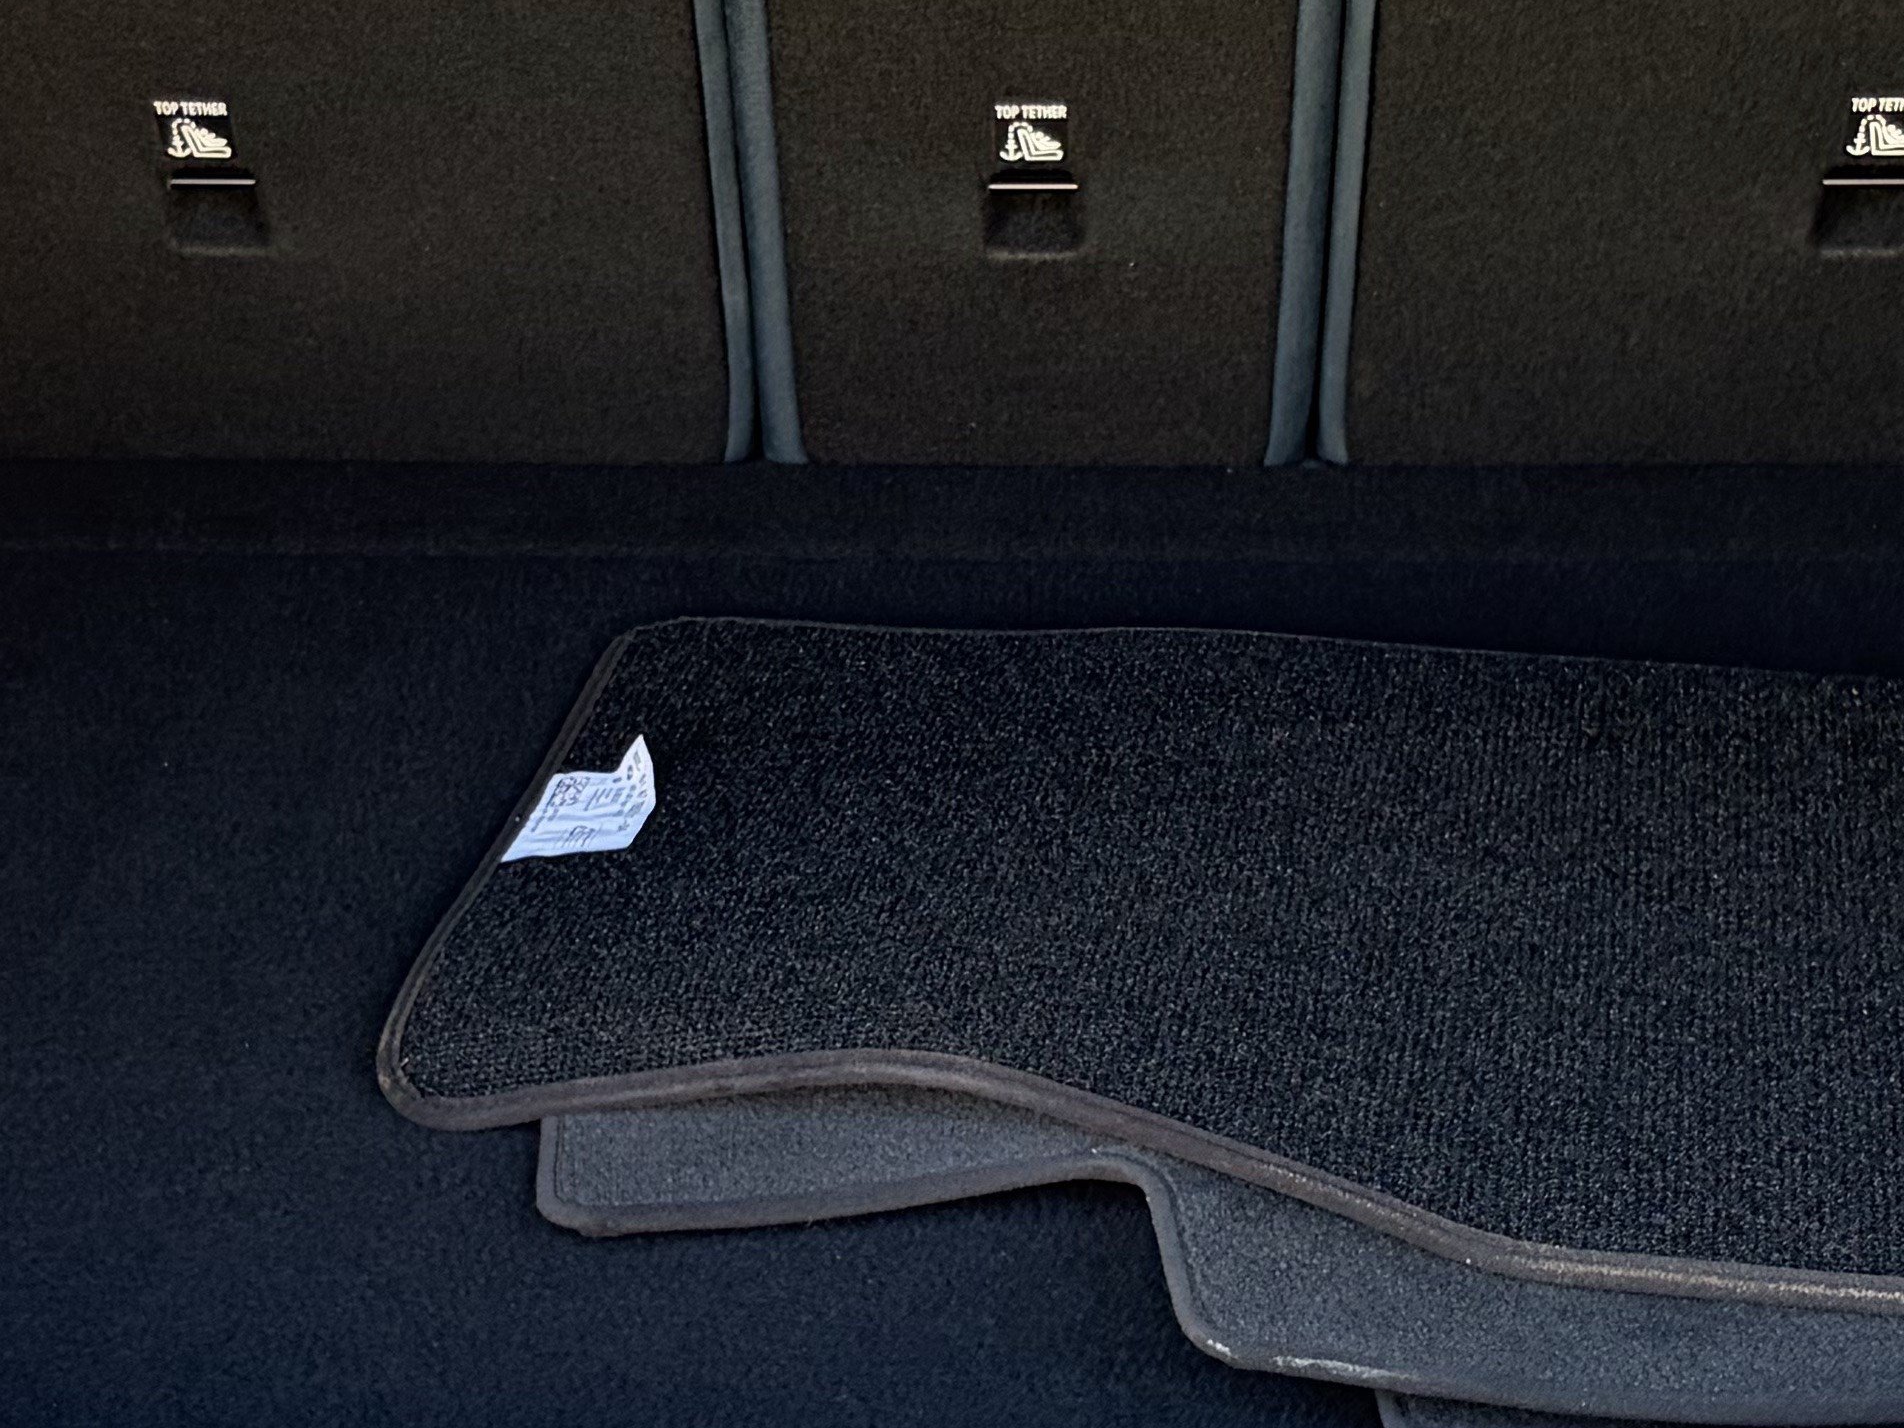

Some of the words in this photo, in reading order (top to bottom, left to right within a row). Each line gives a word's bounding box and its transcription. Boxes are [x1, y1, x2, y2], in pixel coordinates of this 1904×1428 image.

[153, 101, 179, 116] TOP
[179, 101, 228, 117] TETHER
[994, 104, 1020, 120] TOP
[1021, 104, 1068, 120] TETHER
[1851, 96, 1877, 113] TOP
